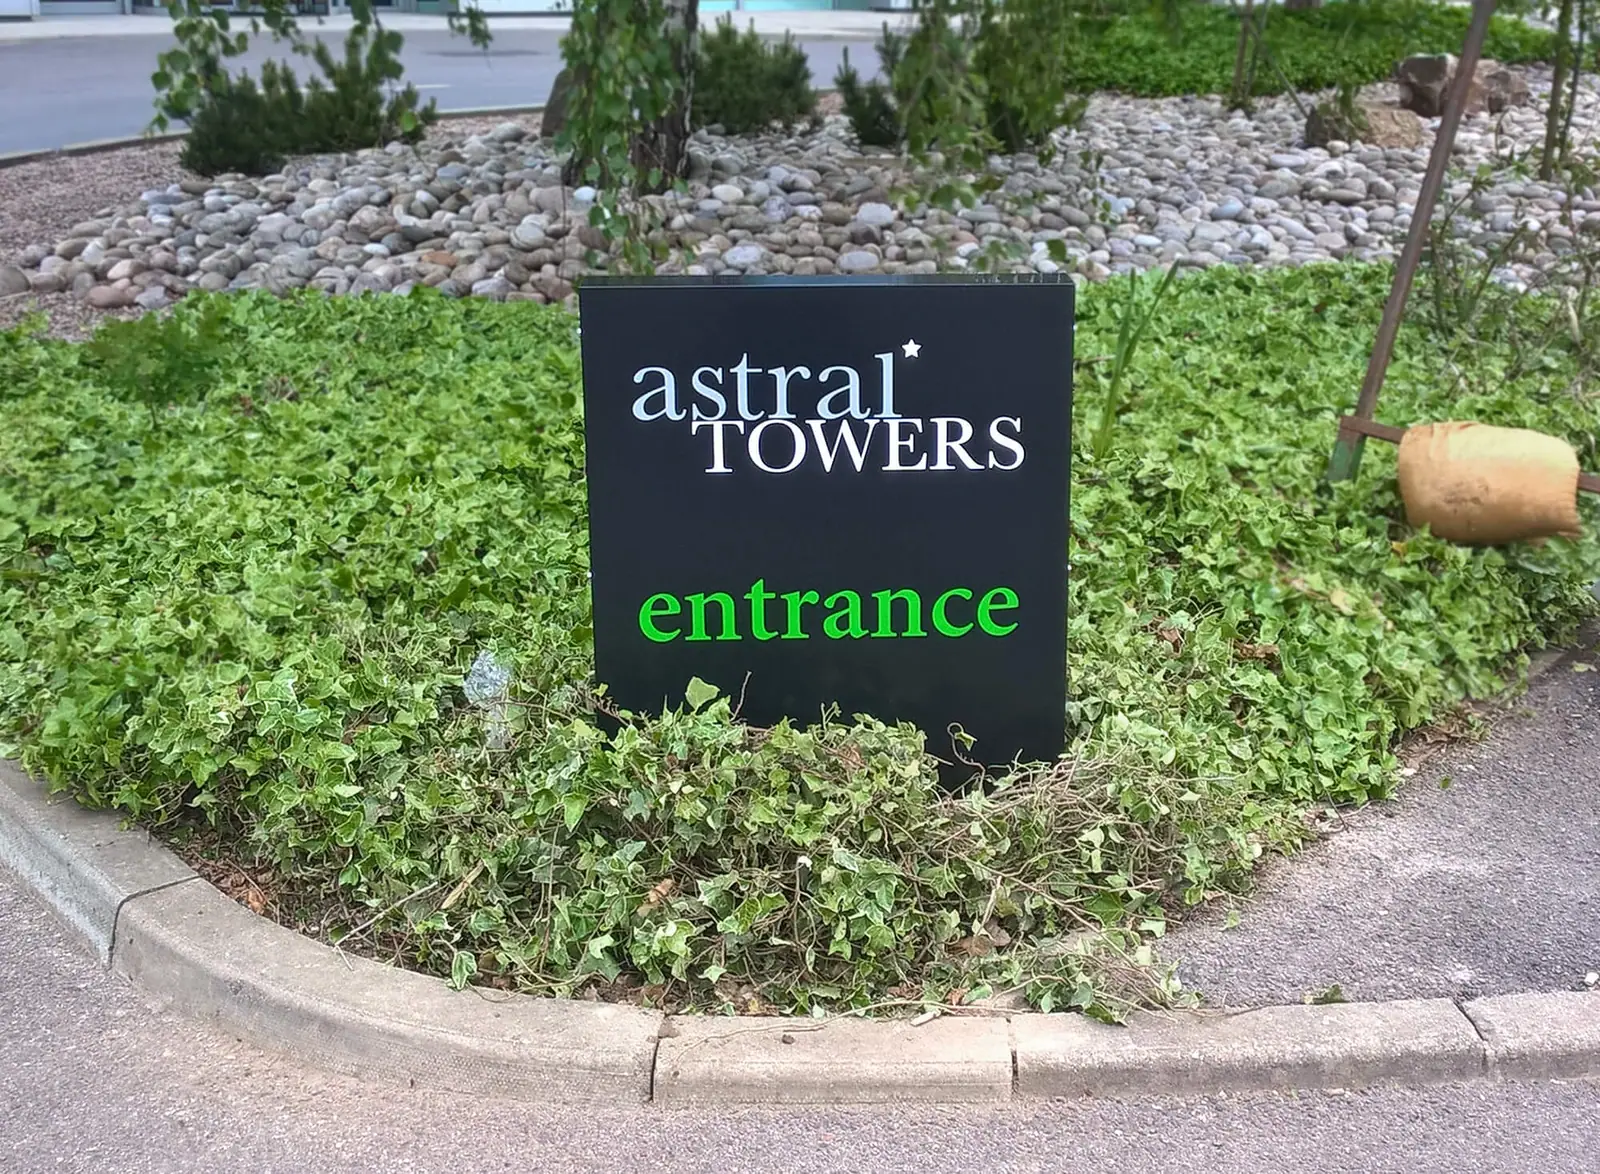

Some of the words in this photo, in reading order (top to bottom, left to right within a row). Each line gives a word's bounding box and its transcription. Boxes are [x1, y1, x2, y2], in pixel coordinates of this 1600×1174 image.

[632, 352, 903, 421] astral
[691, 416, 1025, 473] TOWERS
[638, 578, 1019, 643] entrance
